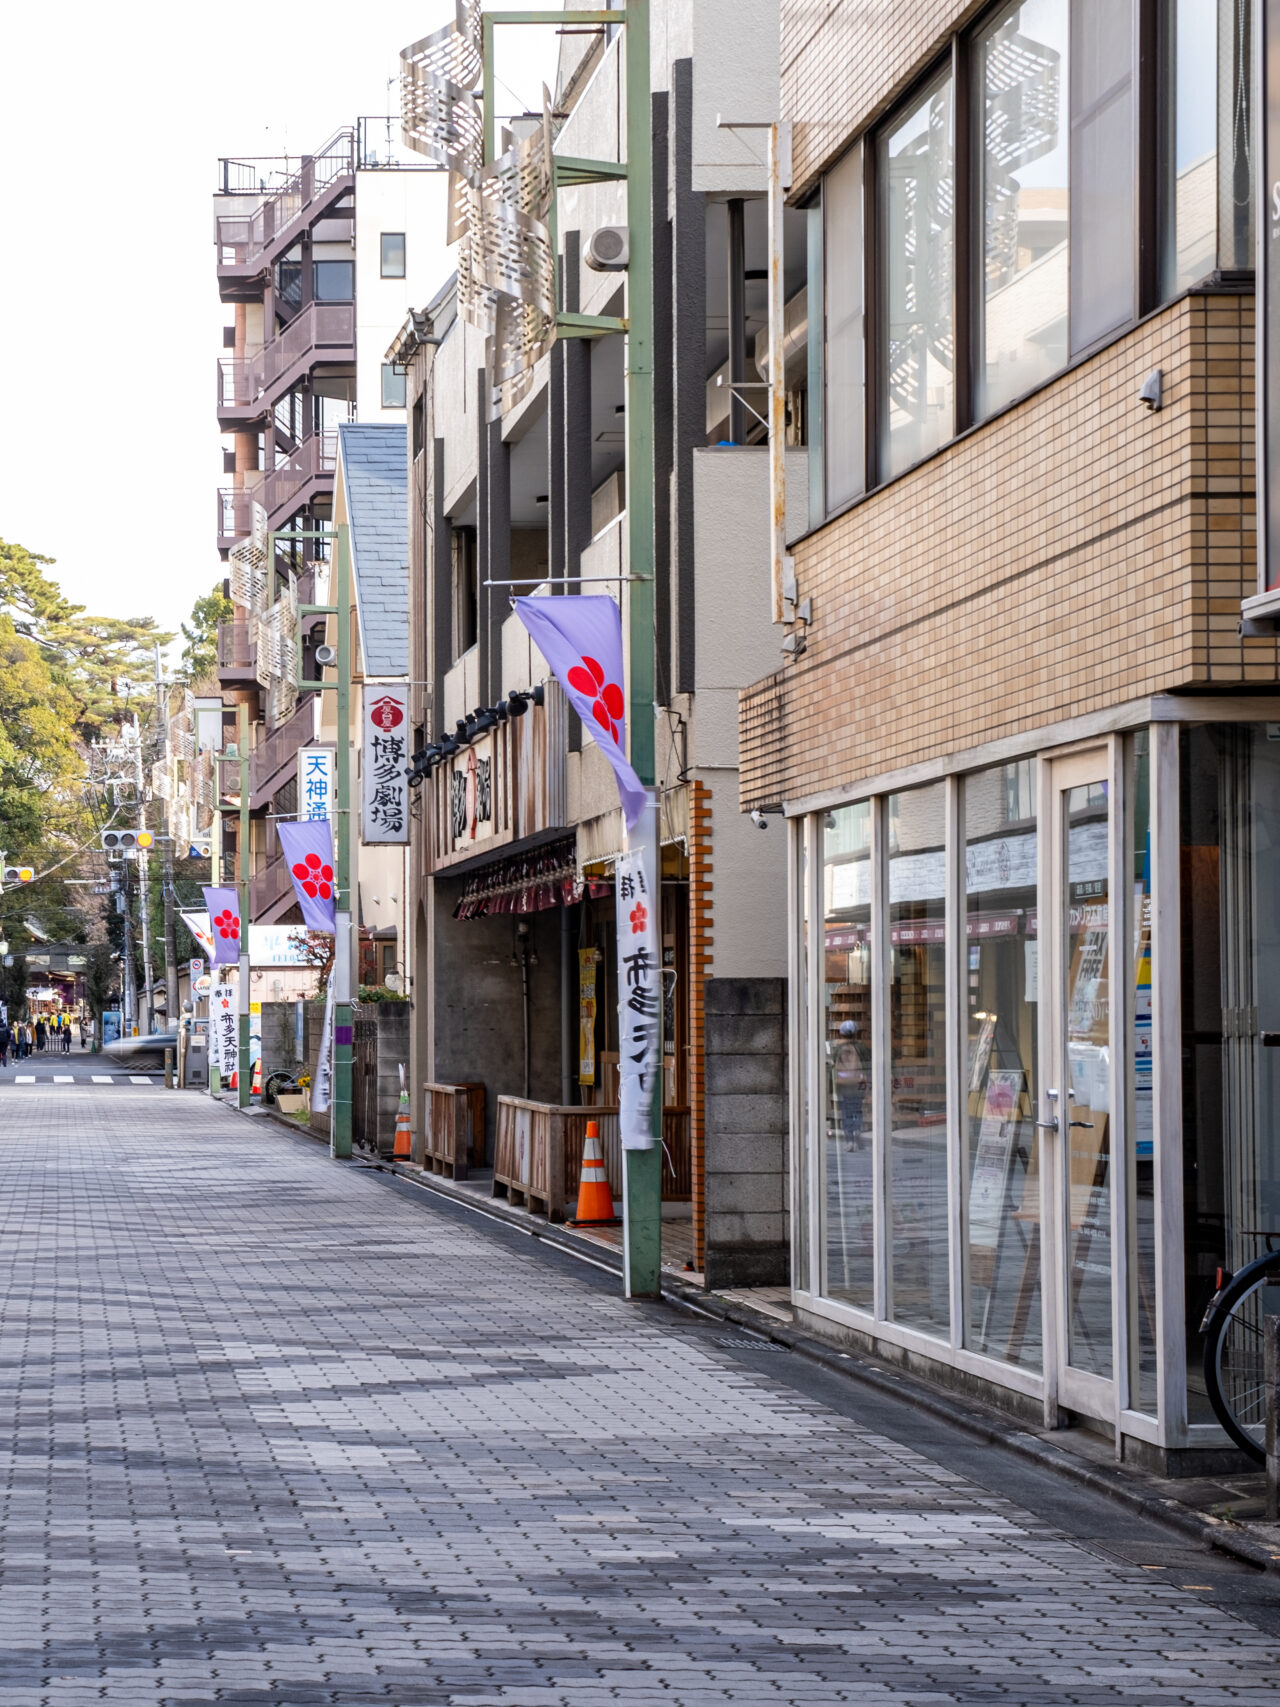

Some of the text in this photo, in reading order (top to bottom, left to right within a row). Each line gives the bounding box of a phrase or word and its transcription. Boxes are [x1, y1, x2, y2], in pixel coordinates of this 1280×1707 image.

[370, 735, 406, 834] 博多劇場
[221, 1012, 238, 1073] 布多天神社
